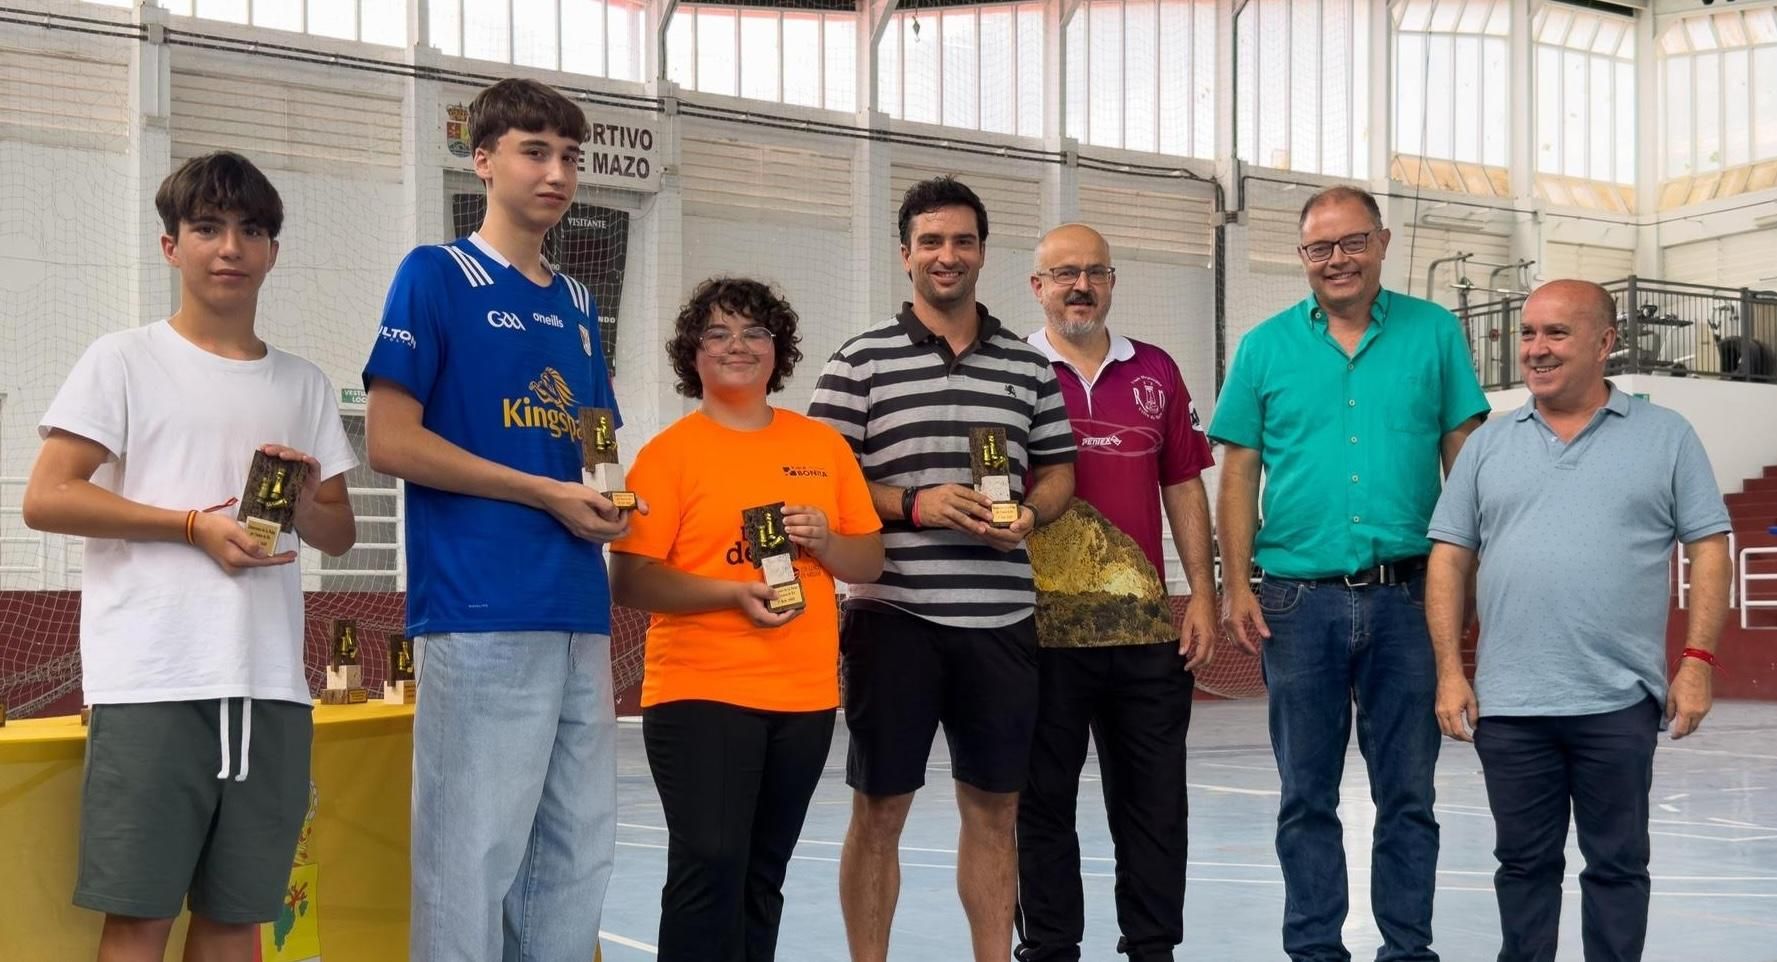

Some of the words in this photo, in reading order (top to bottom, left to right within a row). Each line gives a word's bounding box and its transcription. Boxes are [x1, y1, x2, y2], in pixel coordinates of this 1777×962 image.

[582, 122, 653, 151] ORTIVO
[577, 150, 585, 171] E
[593, 151, 650, 179] MAZO
[567, 217, 607, 229] VISITANTE
[533, 312, 564, 328] oneills
[597, 315, 616, 323] NDO
[352, 396, 368, 404] LOC
